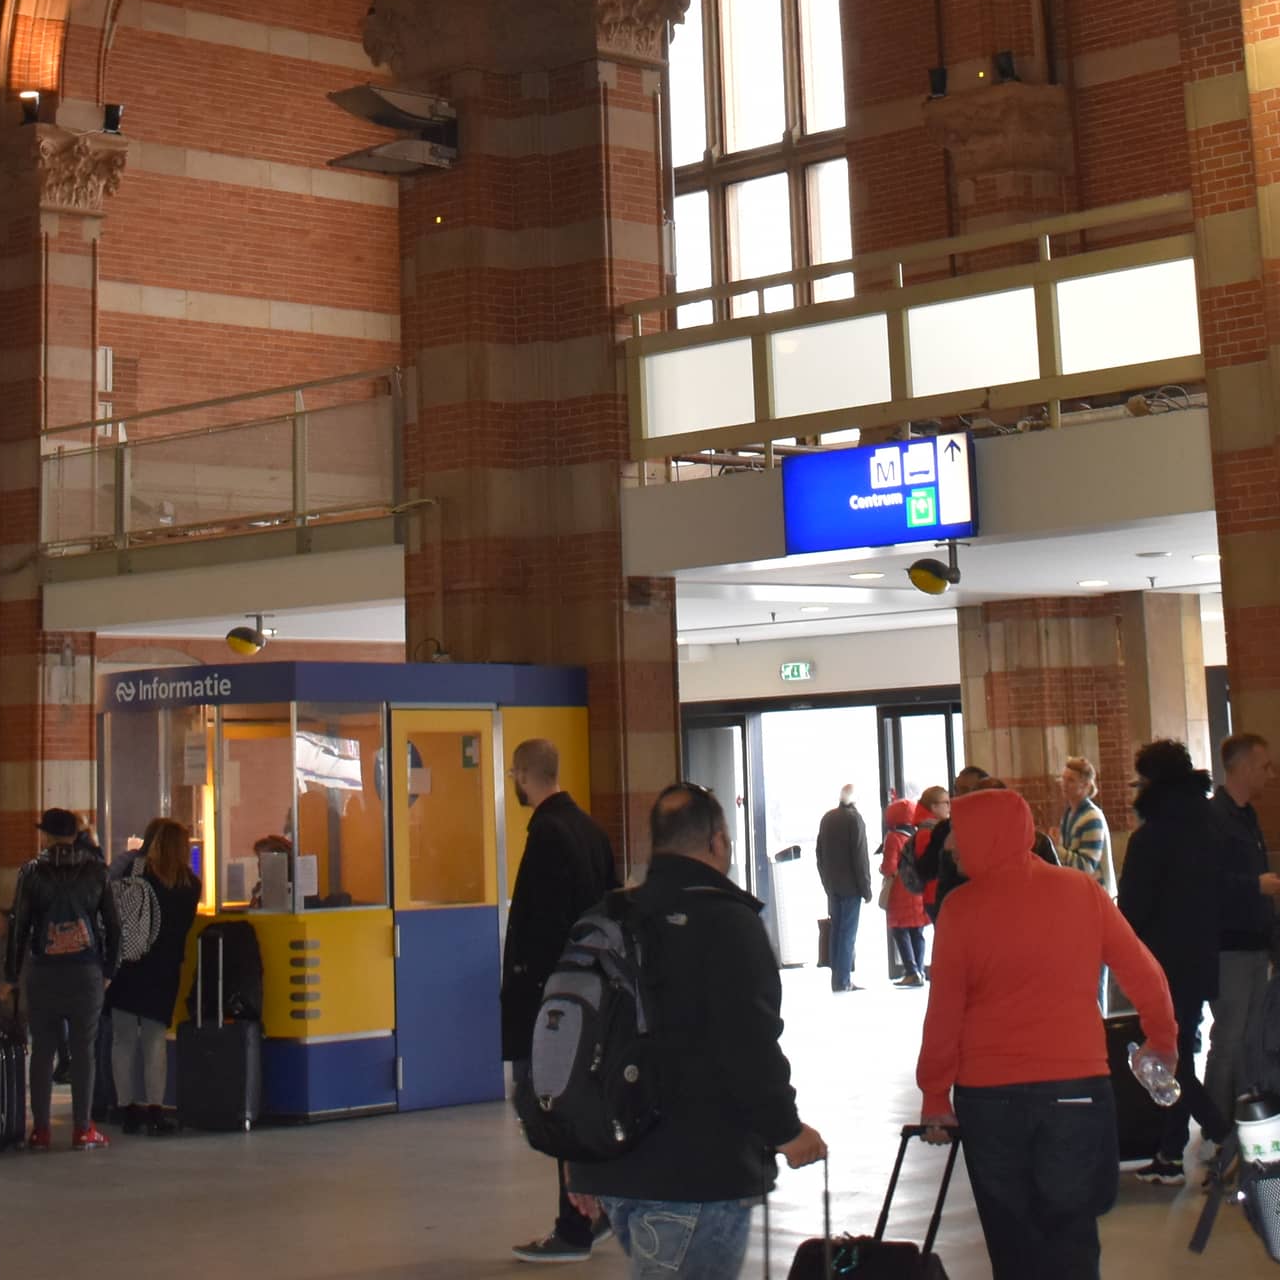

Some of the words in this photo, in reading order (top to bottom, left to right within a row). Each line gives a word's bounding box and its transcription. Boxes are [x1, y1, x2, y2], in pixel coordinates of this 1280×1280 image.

[876, 460, 895, 483] M
[849, 493, 903, 510] Centrum
[139, 673, 232, 701] Informatie
